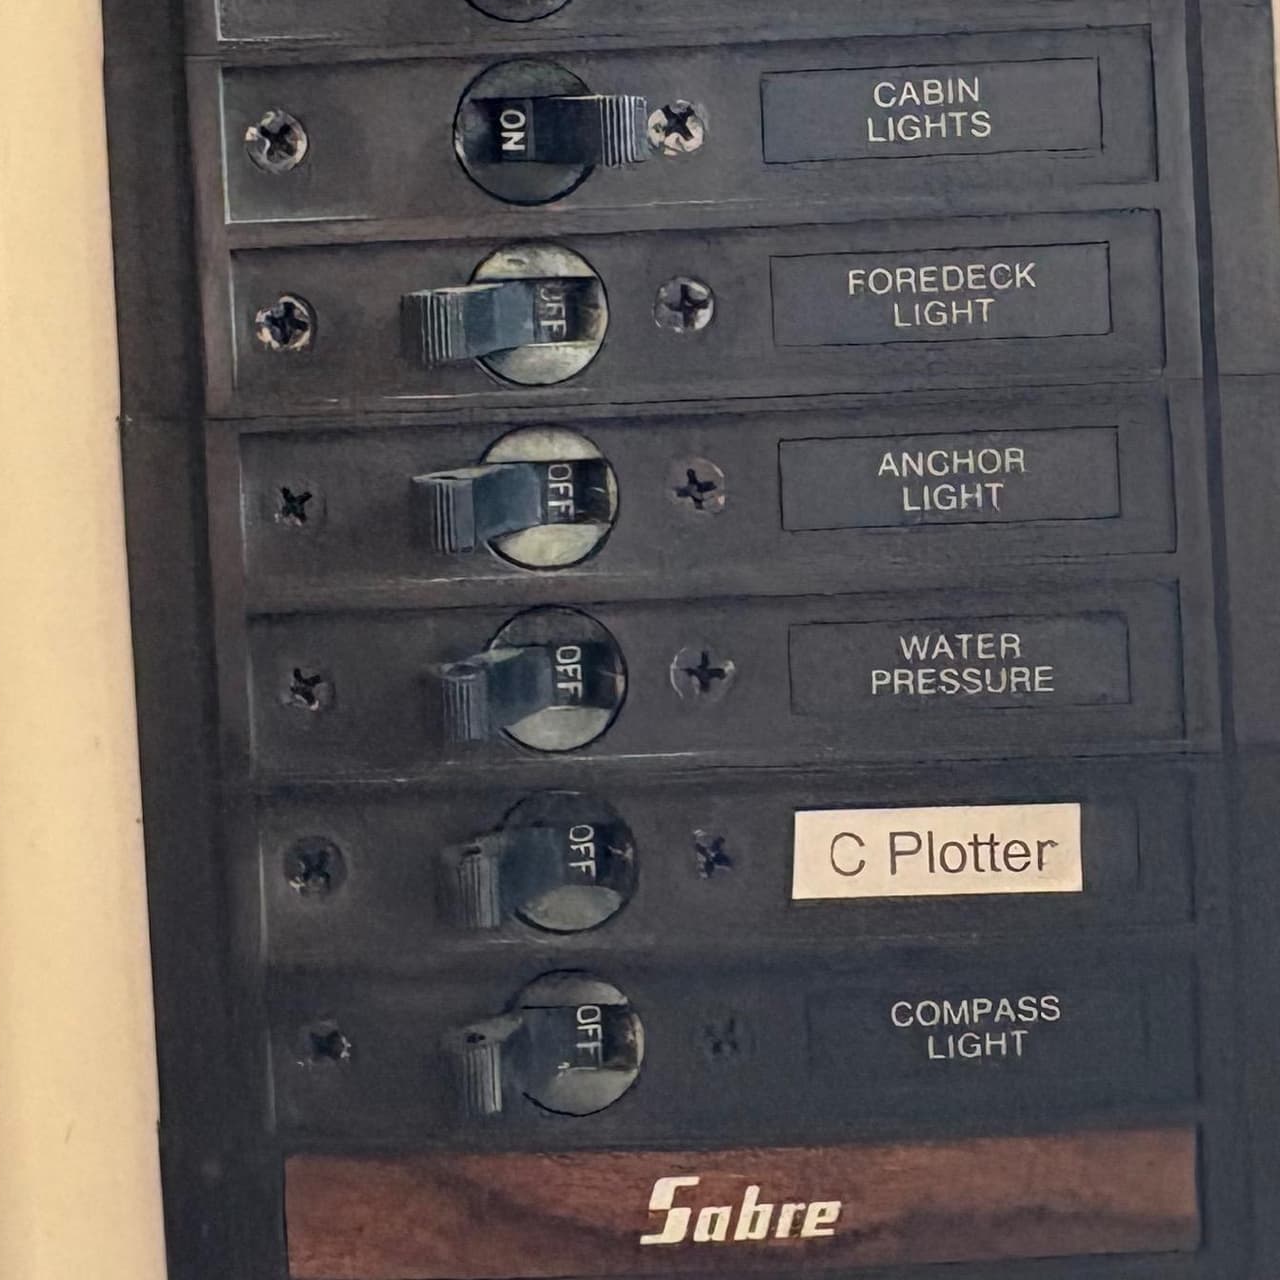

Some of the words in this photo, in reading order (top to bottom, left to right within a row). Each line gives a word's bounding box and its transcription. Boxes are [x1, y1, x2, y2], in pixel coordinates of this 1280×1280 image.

[873, 76, 979, 108] CABIN
[500, 109, 526, 151] ON
[867, 110, 992, 142] LIGHTS
[848, 262, 1036, 295] FOREDECK
[893, 298, 995, 327] LIGHT
[878, 447, 1025, 477] ANCHOR
[547, 463, 575, 518] OFF
[902, 482, 1004, 512] LIGHT
[900, 632, 1021, 661] WATER
[554, 645, 583, 698] OFF
[871, 665, 1055, 695] PRESSURE
[569, 824, 596, 877] OFF
[830, 831, 866, 877] C
[889, 830, 1059, 876] Plotter
[891, 995, 1061, 1027] COMPASS
[576, 1005, 602, 1063] OFF
[927, 1030, 1029, 1059] LIGHT
[639, 1175, 842, 1245] Sabre
